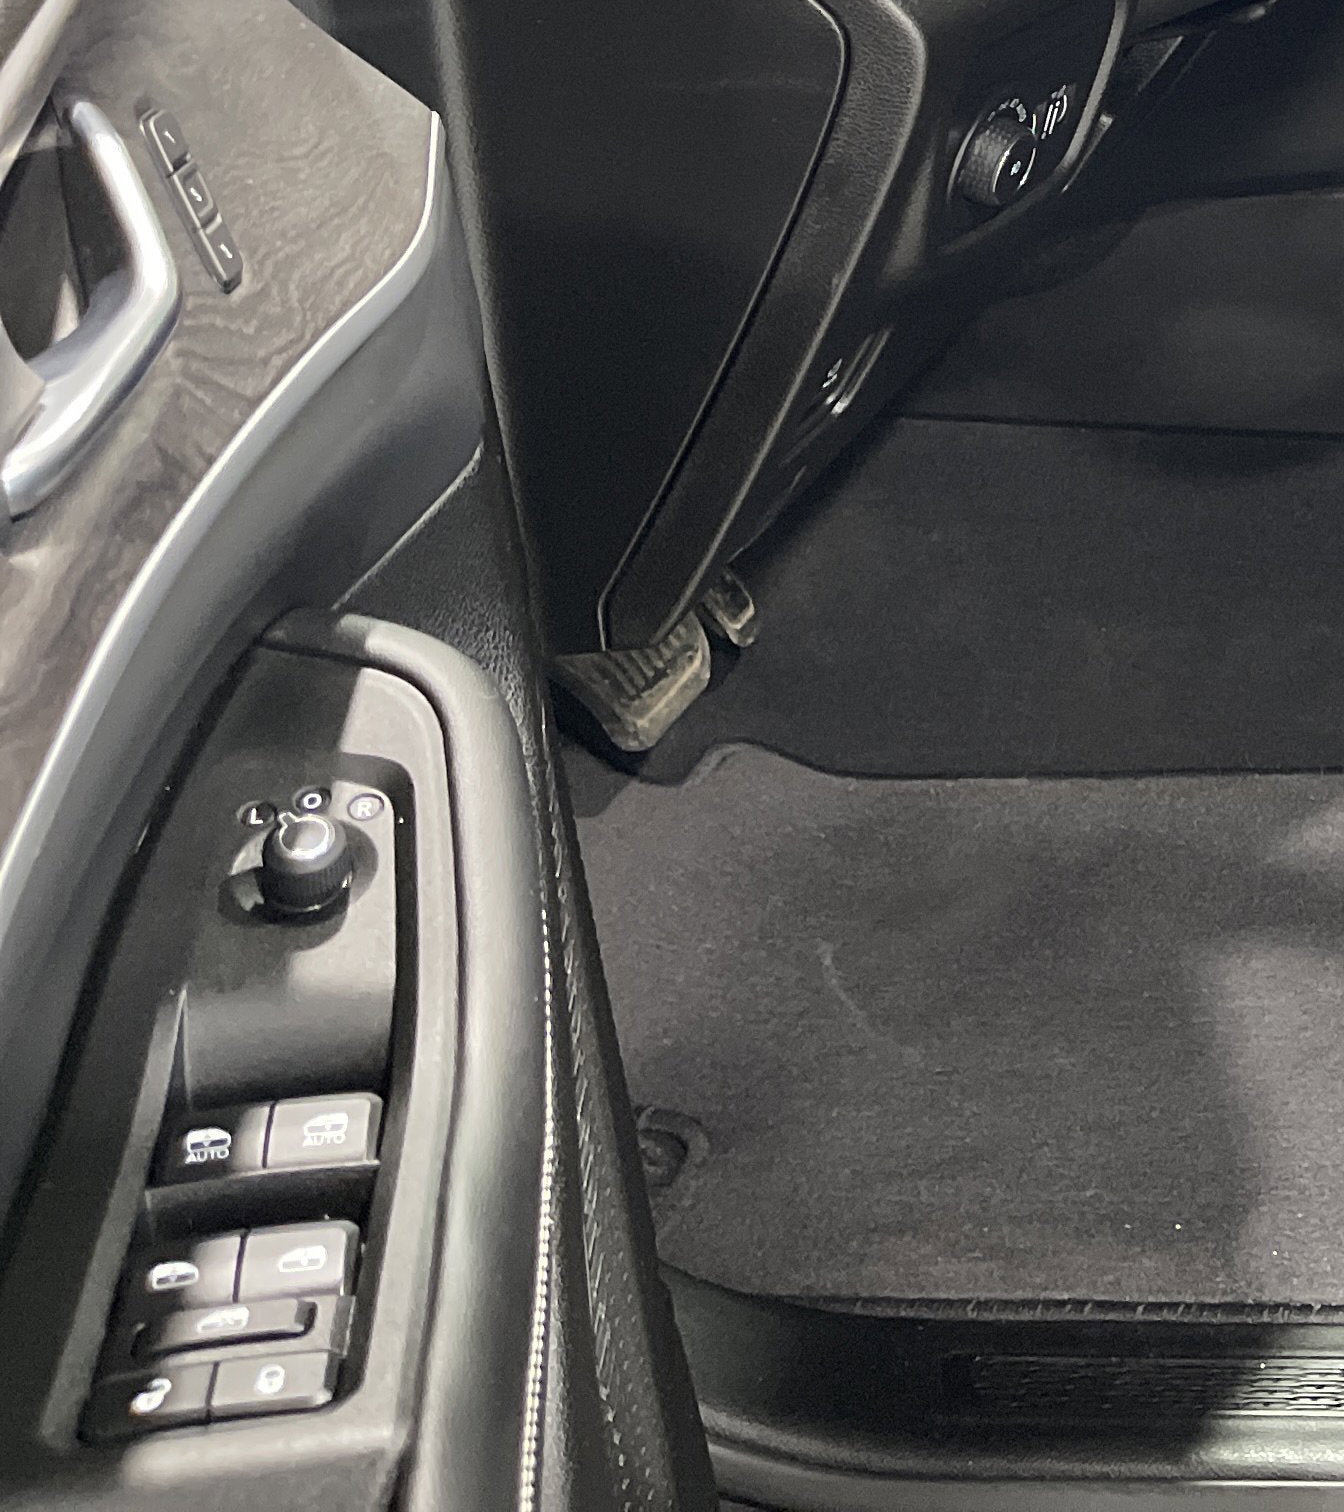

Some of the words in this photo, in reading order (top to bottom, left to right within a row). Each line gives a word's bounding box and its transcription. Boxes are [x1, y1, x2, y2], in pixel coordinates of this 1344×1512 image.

[250, 807, 264, 826] L
[357, 800, 372, 818] R
[302, 1133, 346, 1147] AUTO
[185, 1147, 230, 1163] AUTO
